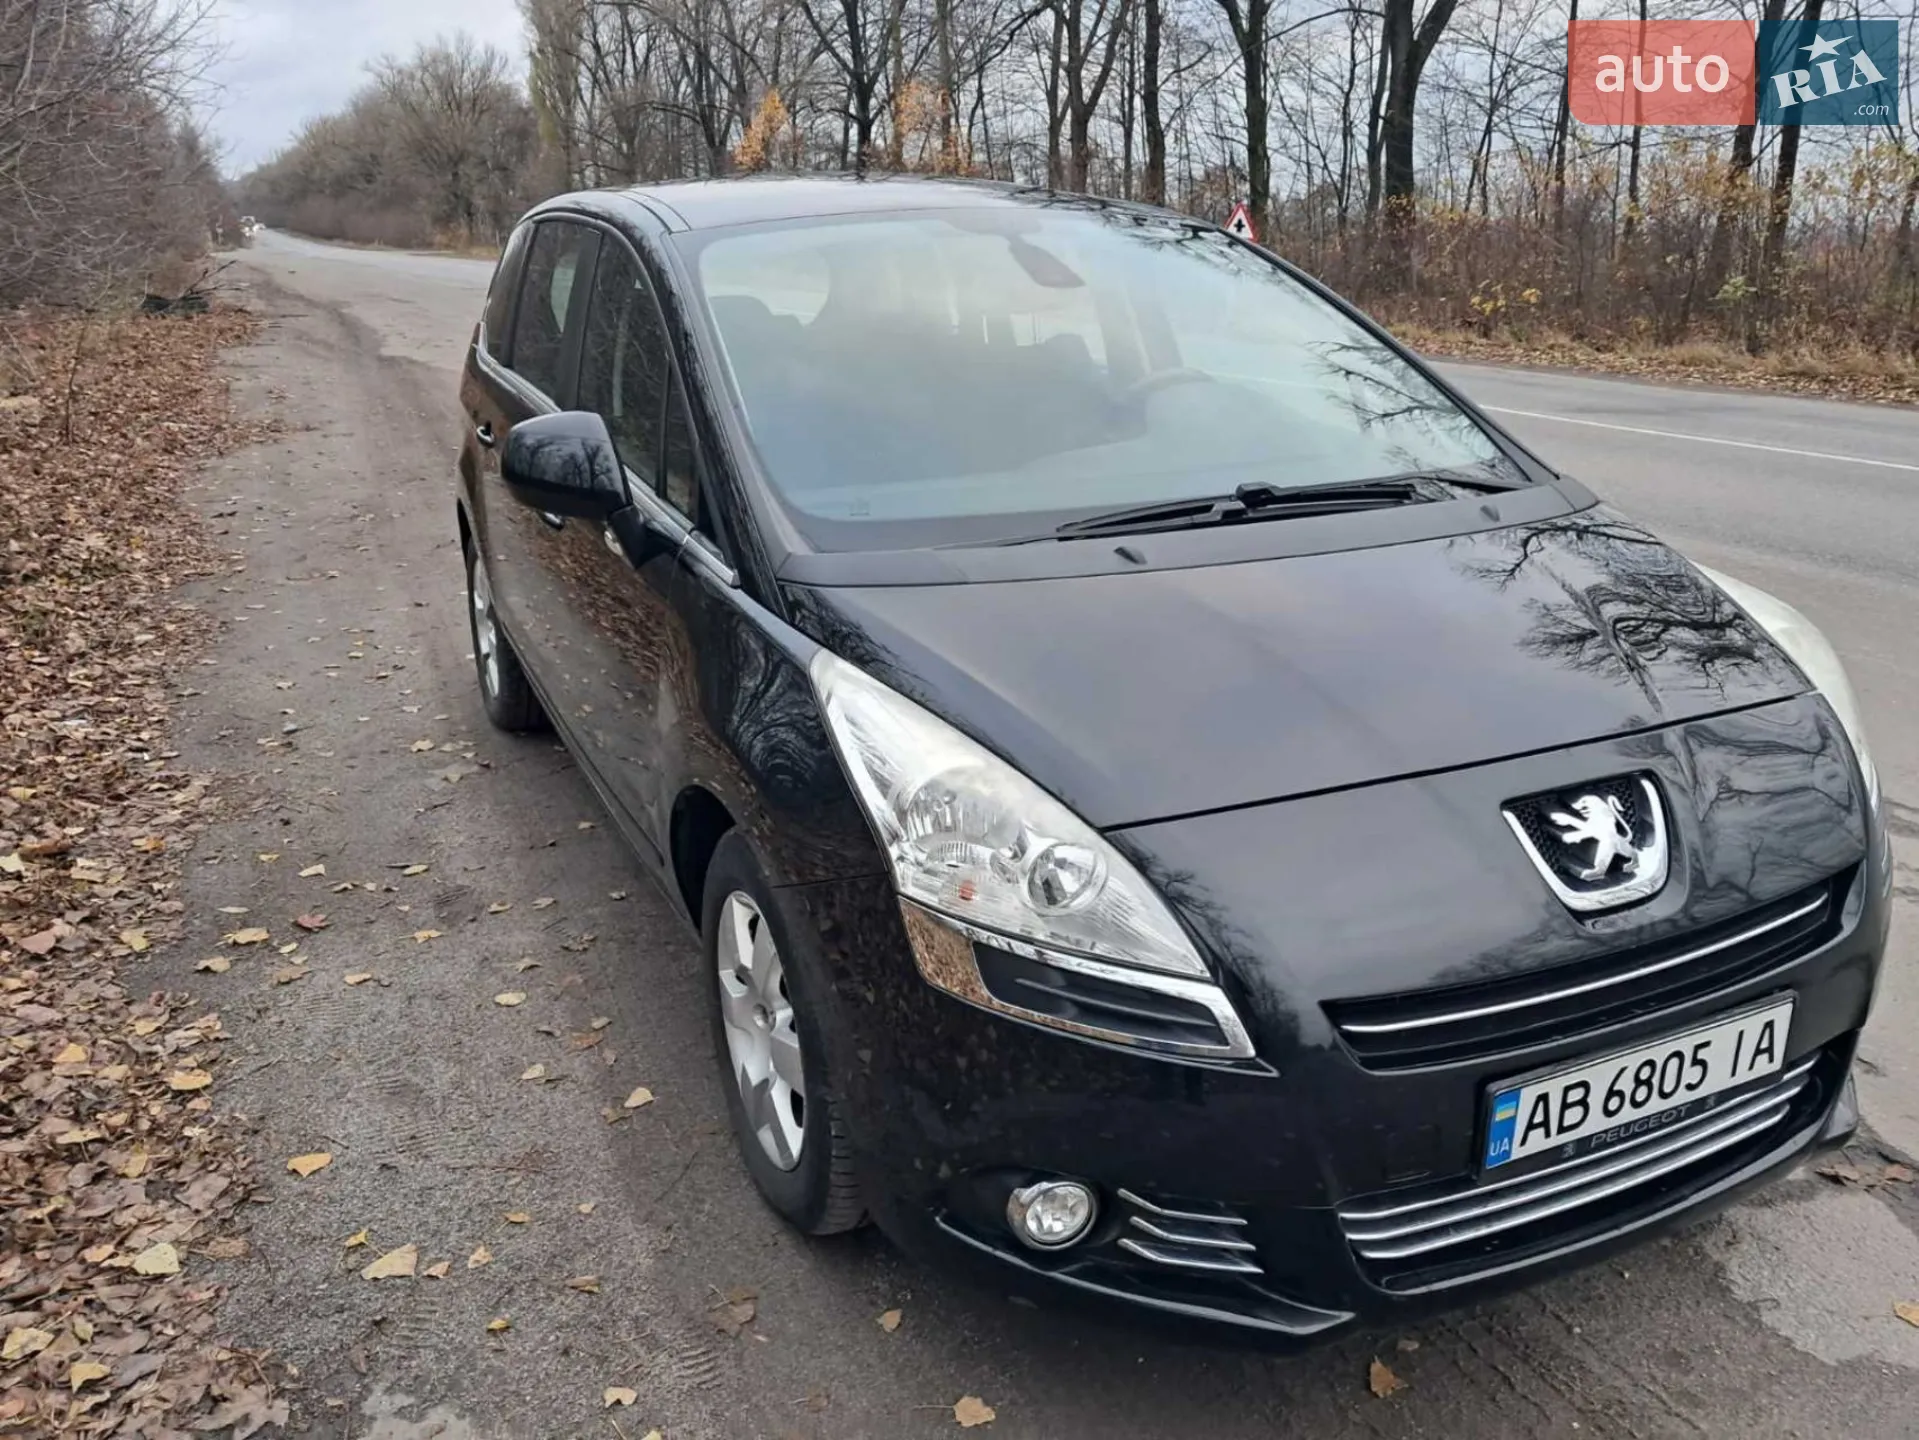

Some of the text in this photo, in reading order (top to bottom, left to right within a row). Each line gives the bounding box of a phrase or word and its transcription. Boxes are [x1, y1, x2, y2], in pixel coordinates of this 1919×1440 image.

[1520, 1019, 1776, 1147] AB 6805 IA
[1589, 1104, 1692, 1148] PEUGEOT
[1489, 1141, 1510, 1156] UA
